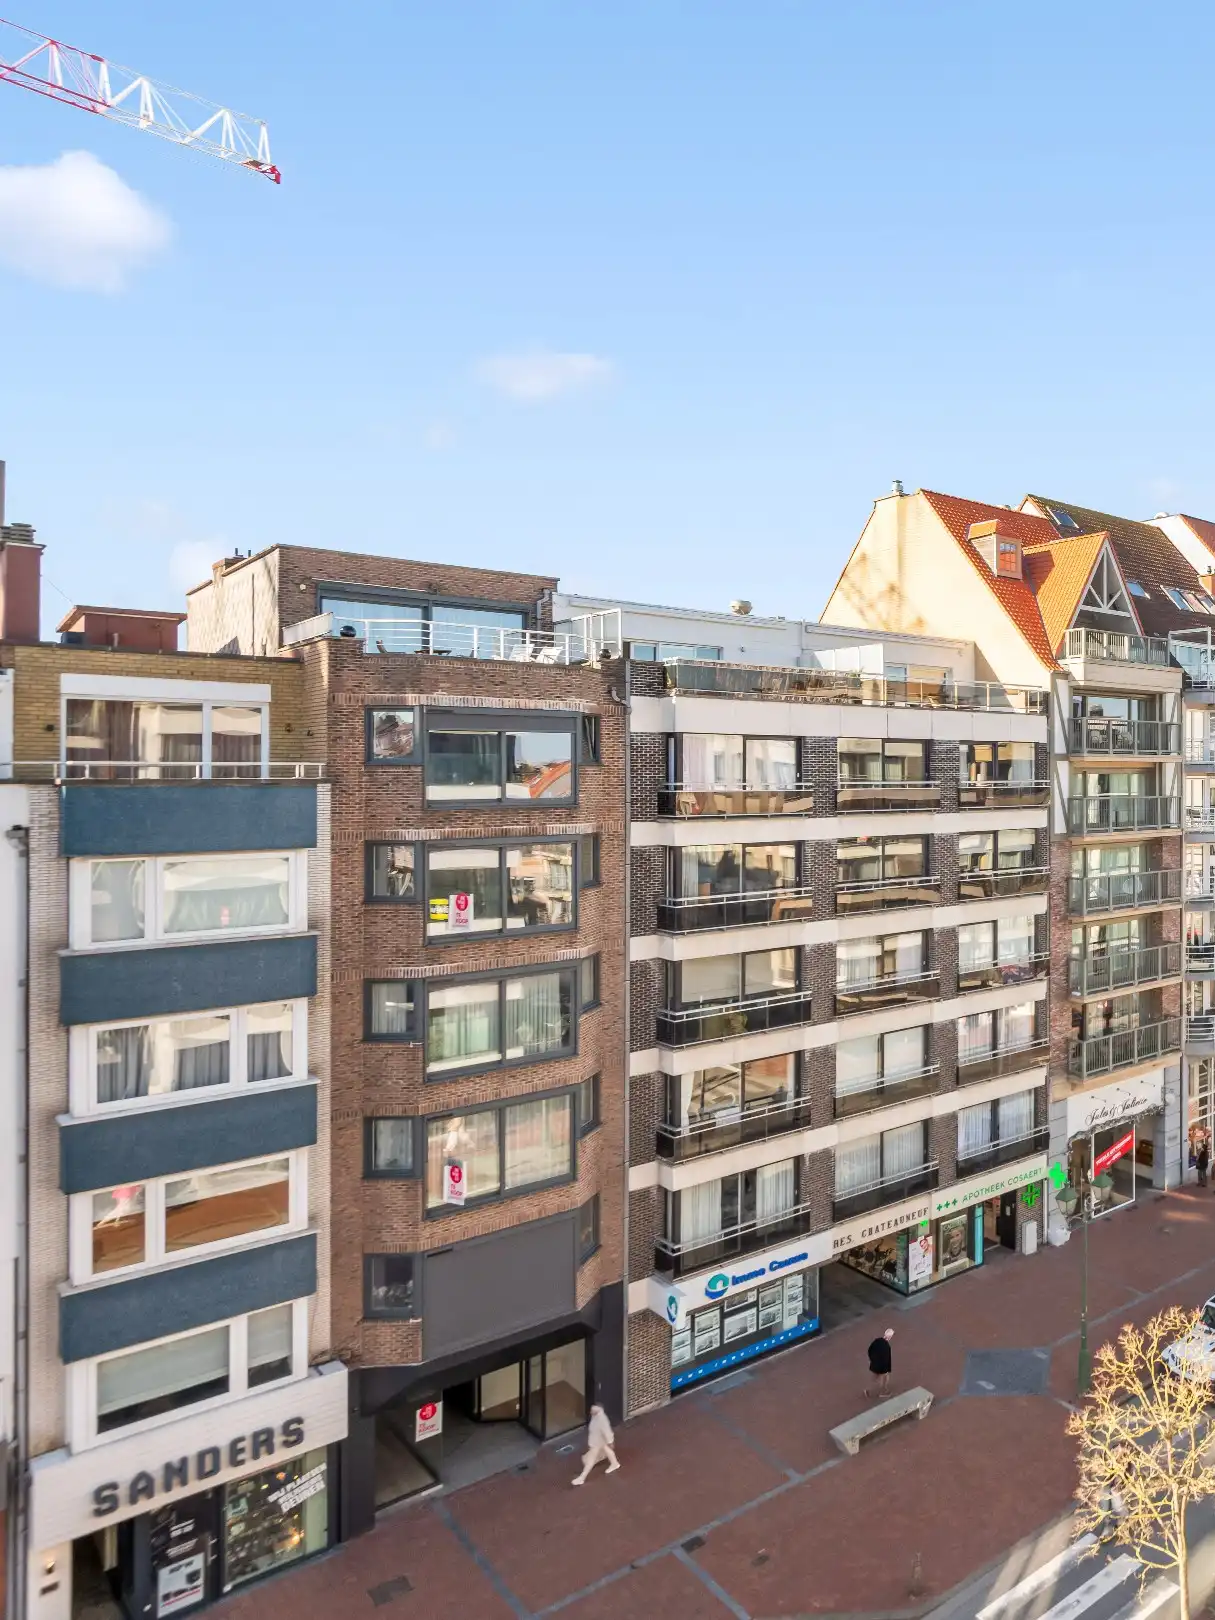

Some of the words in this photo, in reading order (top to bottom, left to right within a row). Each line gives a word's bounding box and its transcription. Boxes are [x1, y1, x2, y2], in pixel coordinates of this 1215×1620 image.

[962, 1181, 1005, 1203] APOTHEEK
[1007, 1167, 1042, 1186] COSAERT
[93, 1416, 305, 1517] SANDERS
